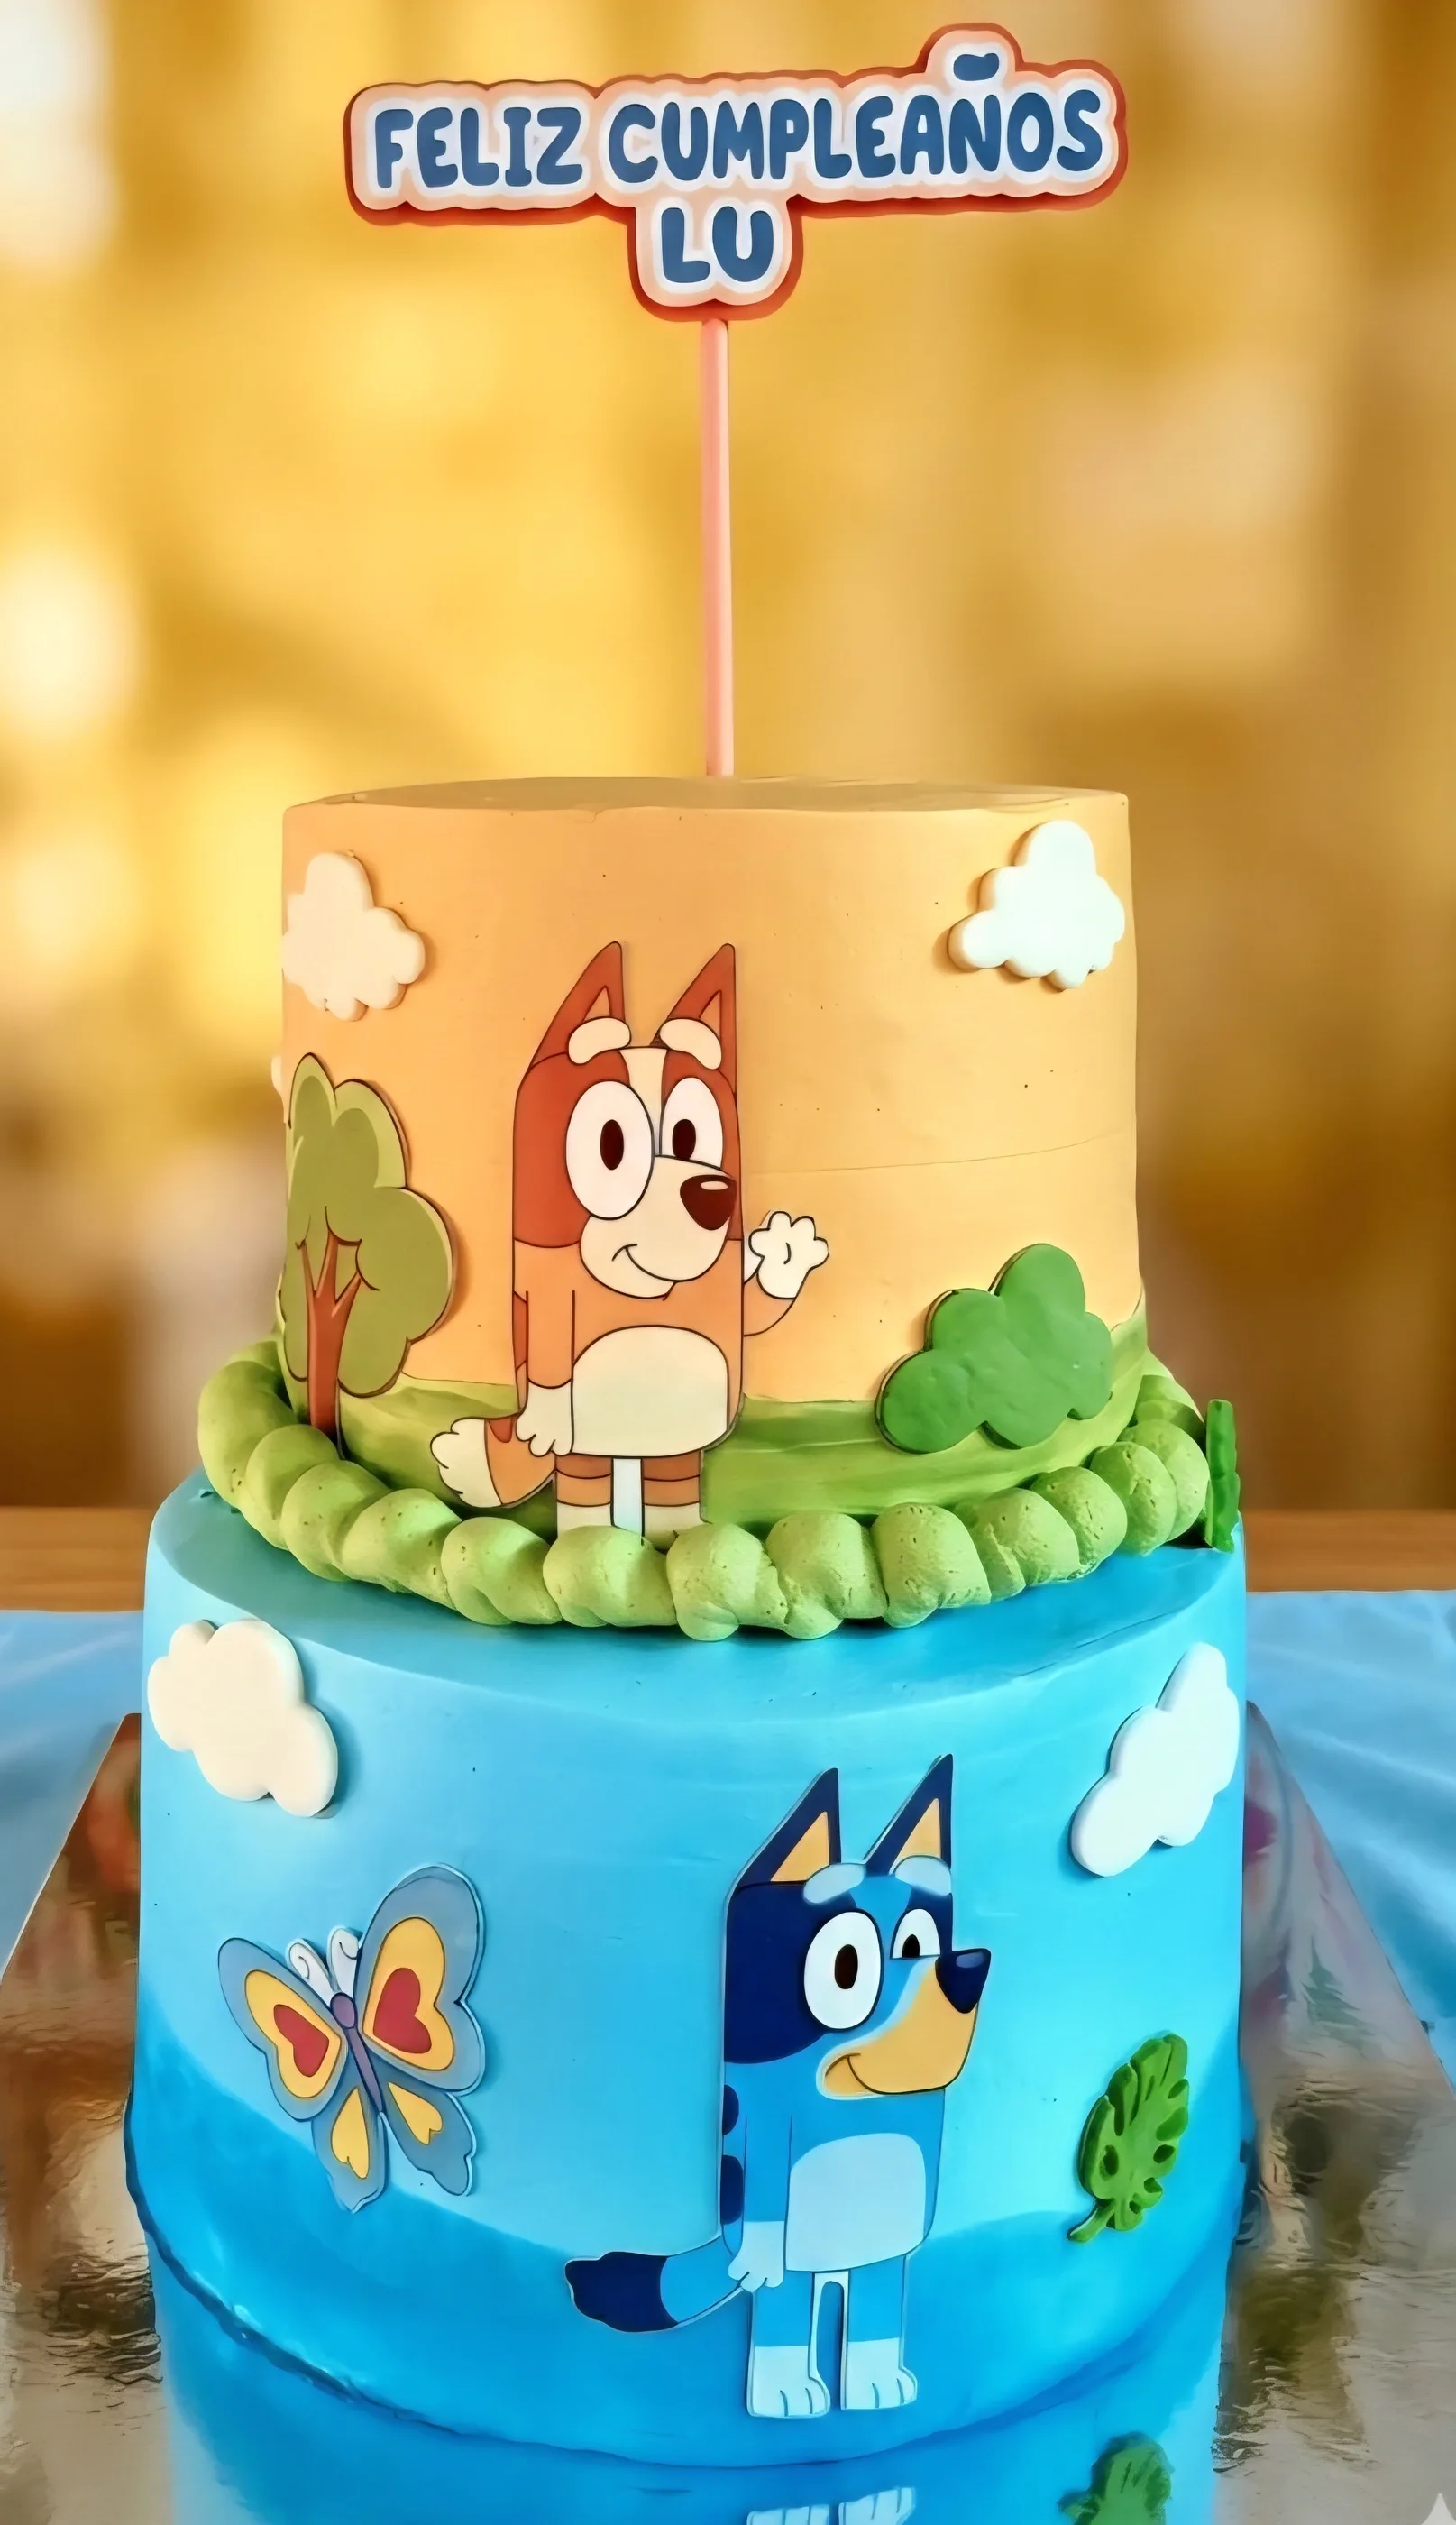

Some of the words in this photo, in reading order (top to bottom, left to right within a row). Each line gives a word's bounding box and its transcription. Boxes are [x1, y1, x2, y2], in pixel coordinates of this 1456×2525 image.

[374, 107, 582, 188] FELIZ
[608, 51, 1103, 184] CUMPLEAÑOS
[661, 206, 774, 284] LU
